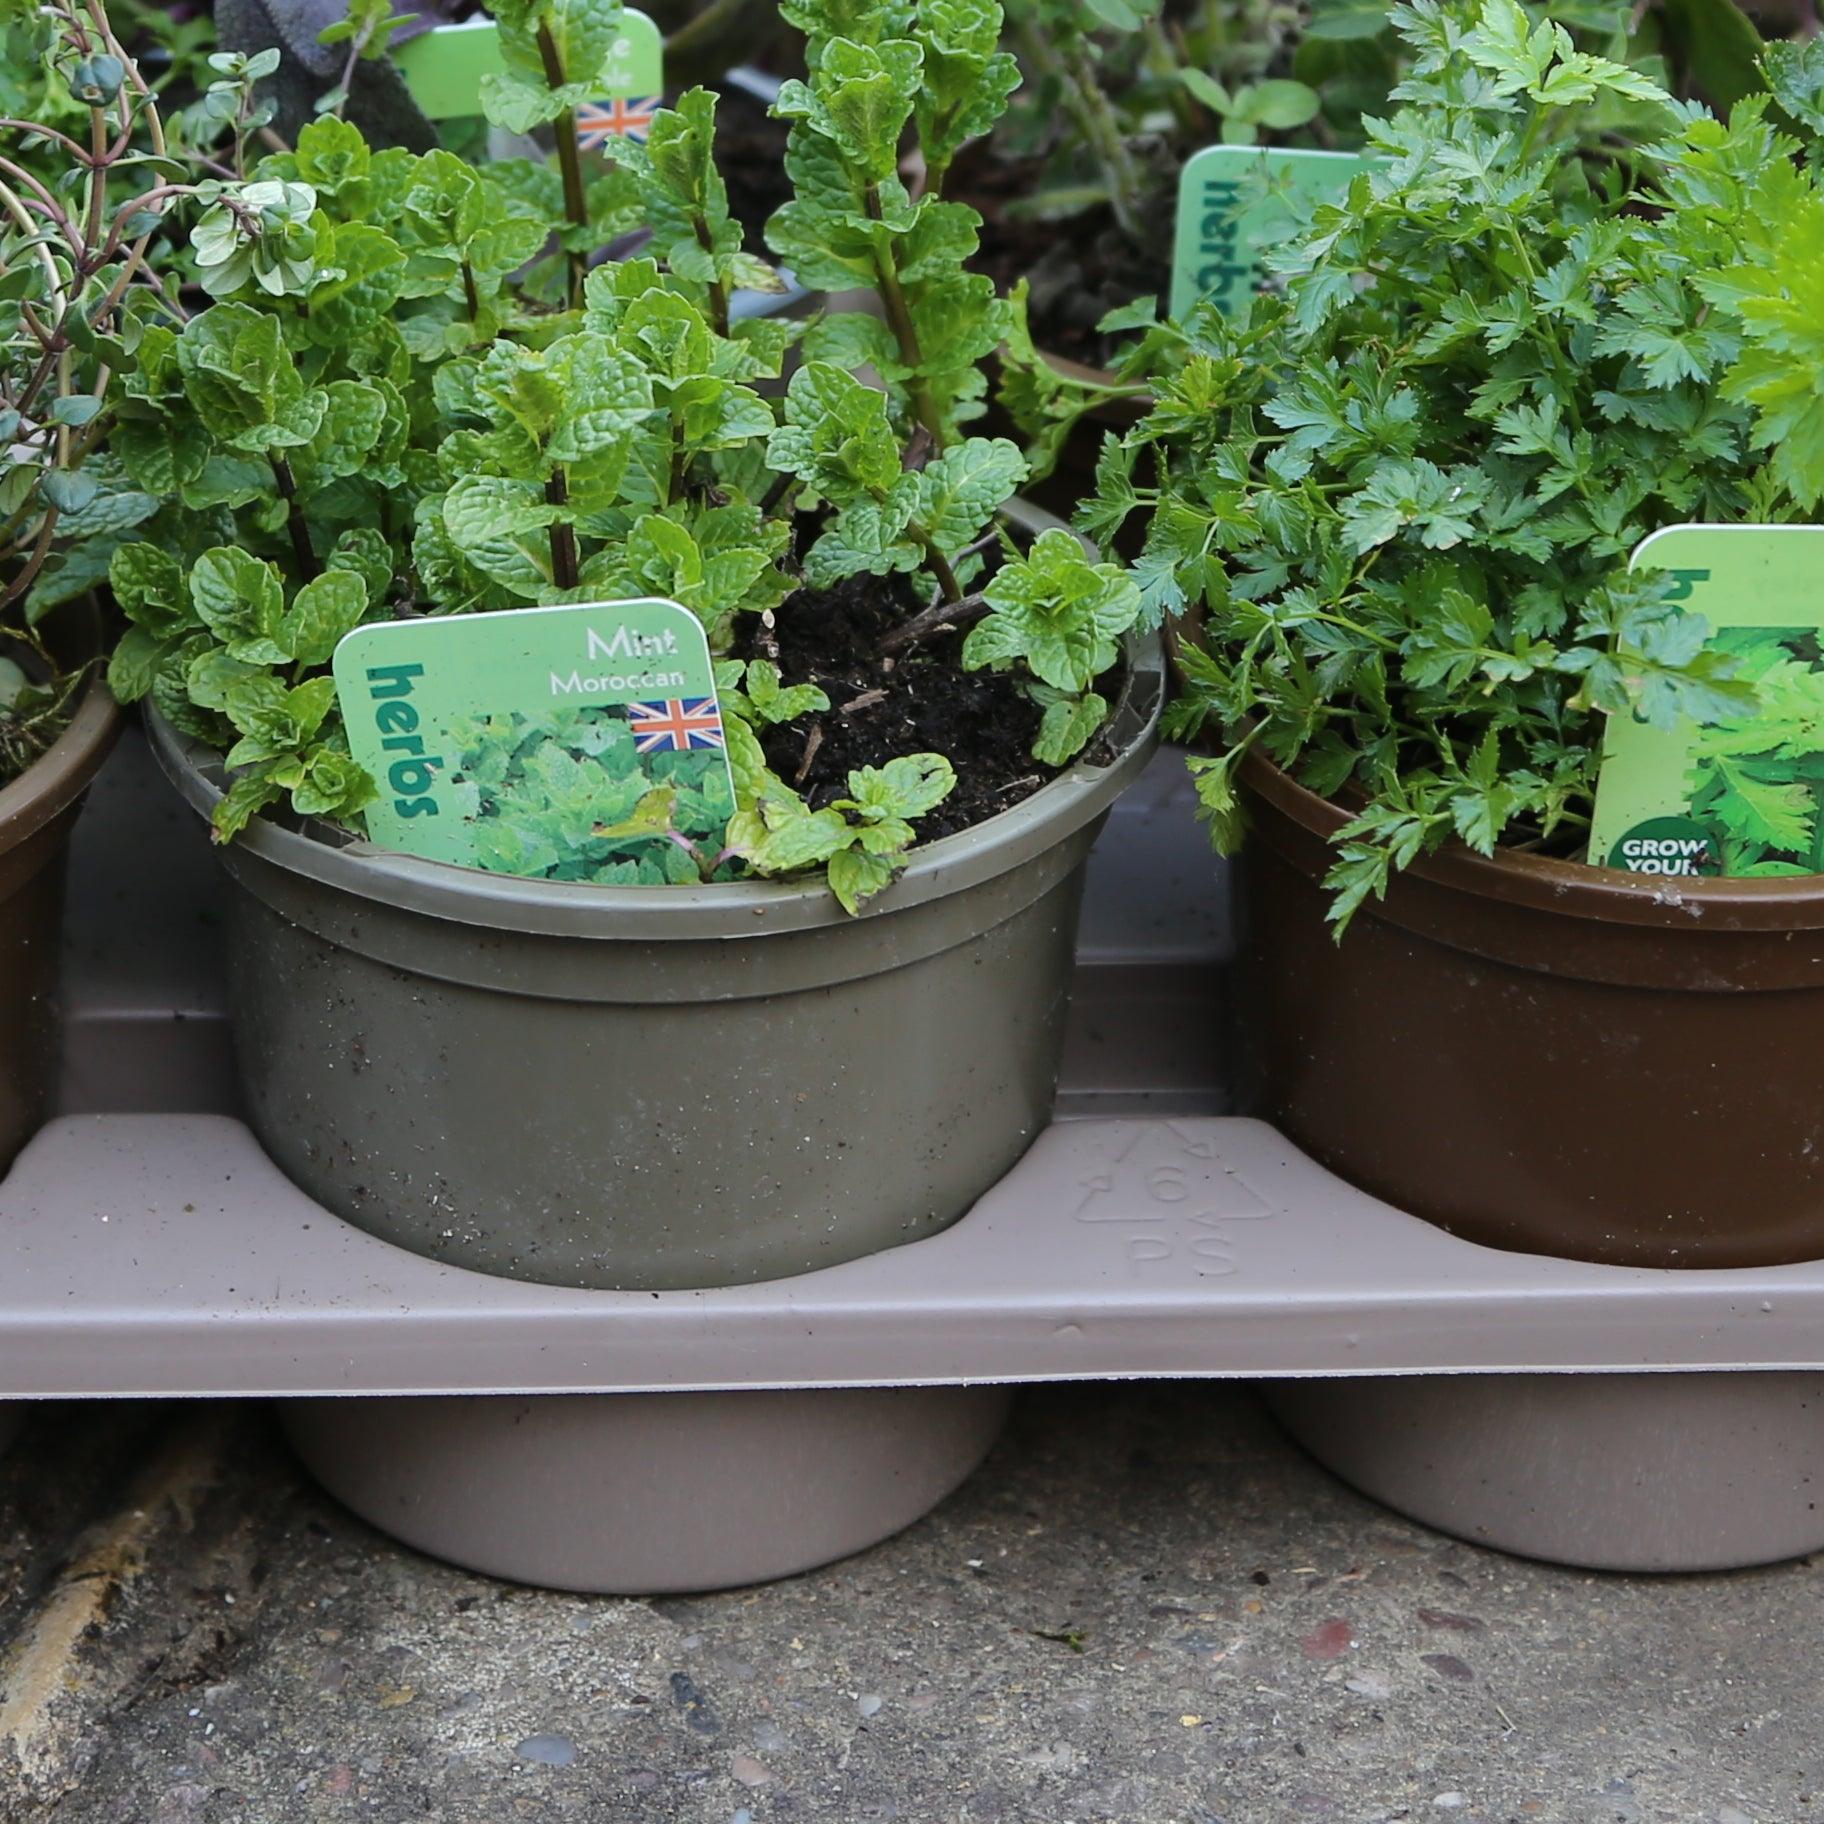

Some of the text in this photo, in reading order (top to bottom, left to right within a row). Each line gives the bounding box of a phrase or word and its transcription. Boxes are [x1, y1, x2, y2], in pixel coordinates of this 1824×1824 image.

[1196, 179, 1248, 316] herb
[586, 624, 679, 661] Mint
[549, 669, 685, 697] Moroccan
[365, 662, 444, 821] herbs
[1621, 838, 1709, 858] GROW
[1127, 1236, 1239, 1277] PS
